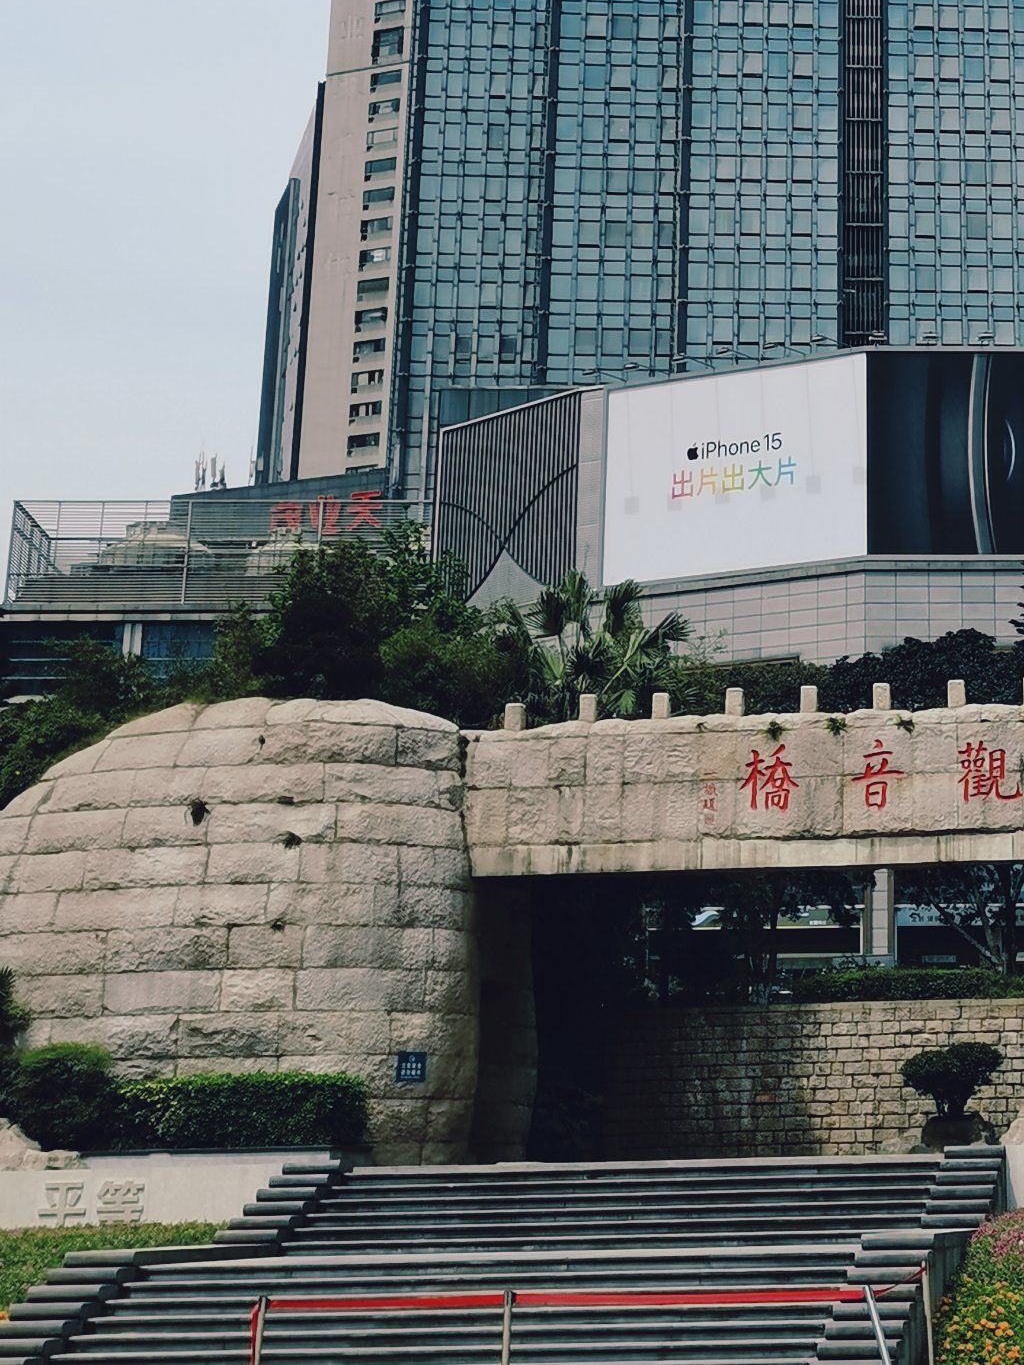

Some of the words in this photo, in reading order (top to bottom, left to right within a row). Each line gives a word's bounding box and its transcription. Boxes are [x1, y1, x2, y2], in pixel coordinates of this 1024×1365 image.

[701, 437, 761, 460] iPhone
[764, 432, 782, 452] 15
[671, 455, 797, 500] 出片出大片
[37, 1178, 145, 1226] 平等
